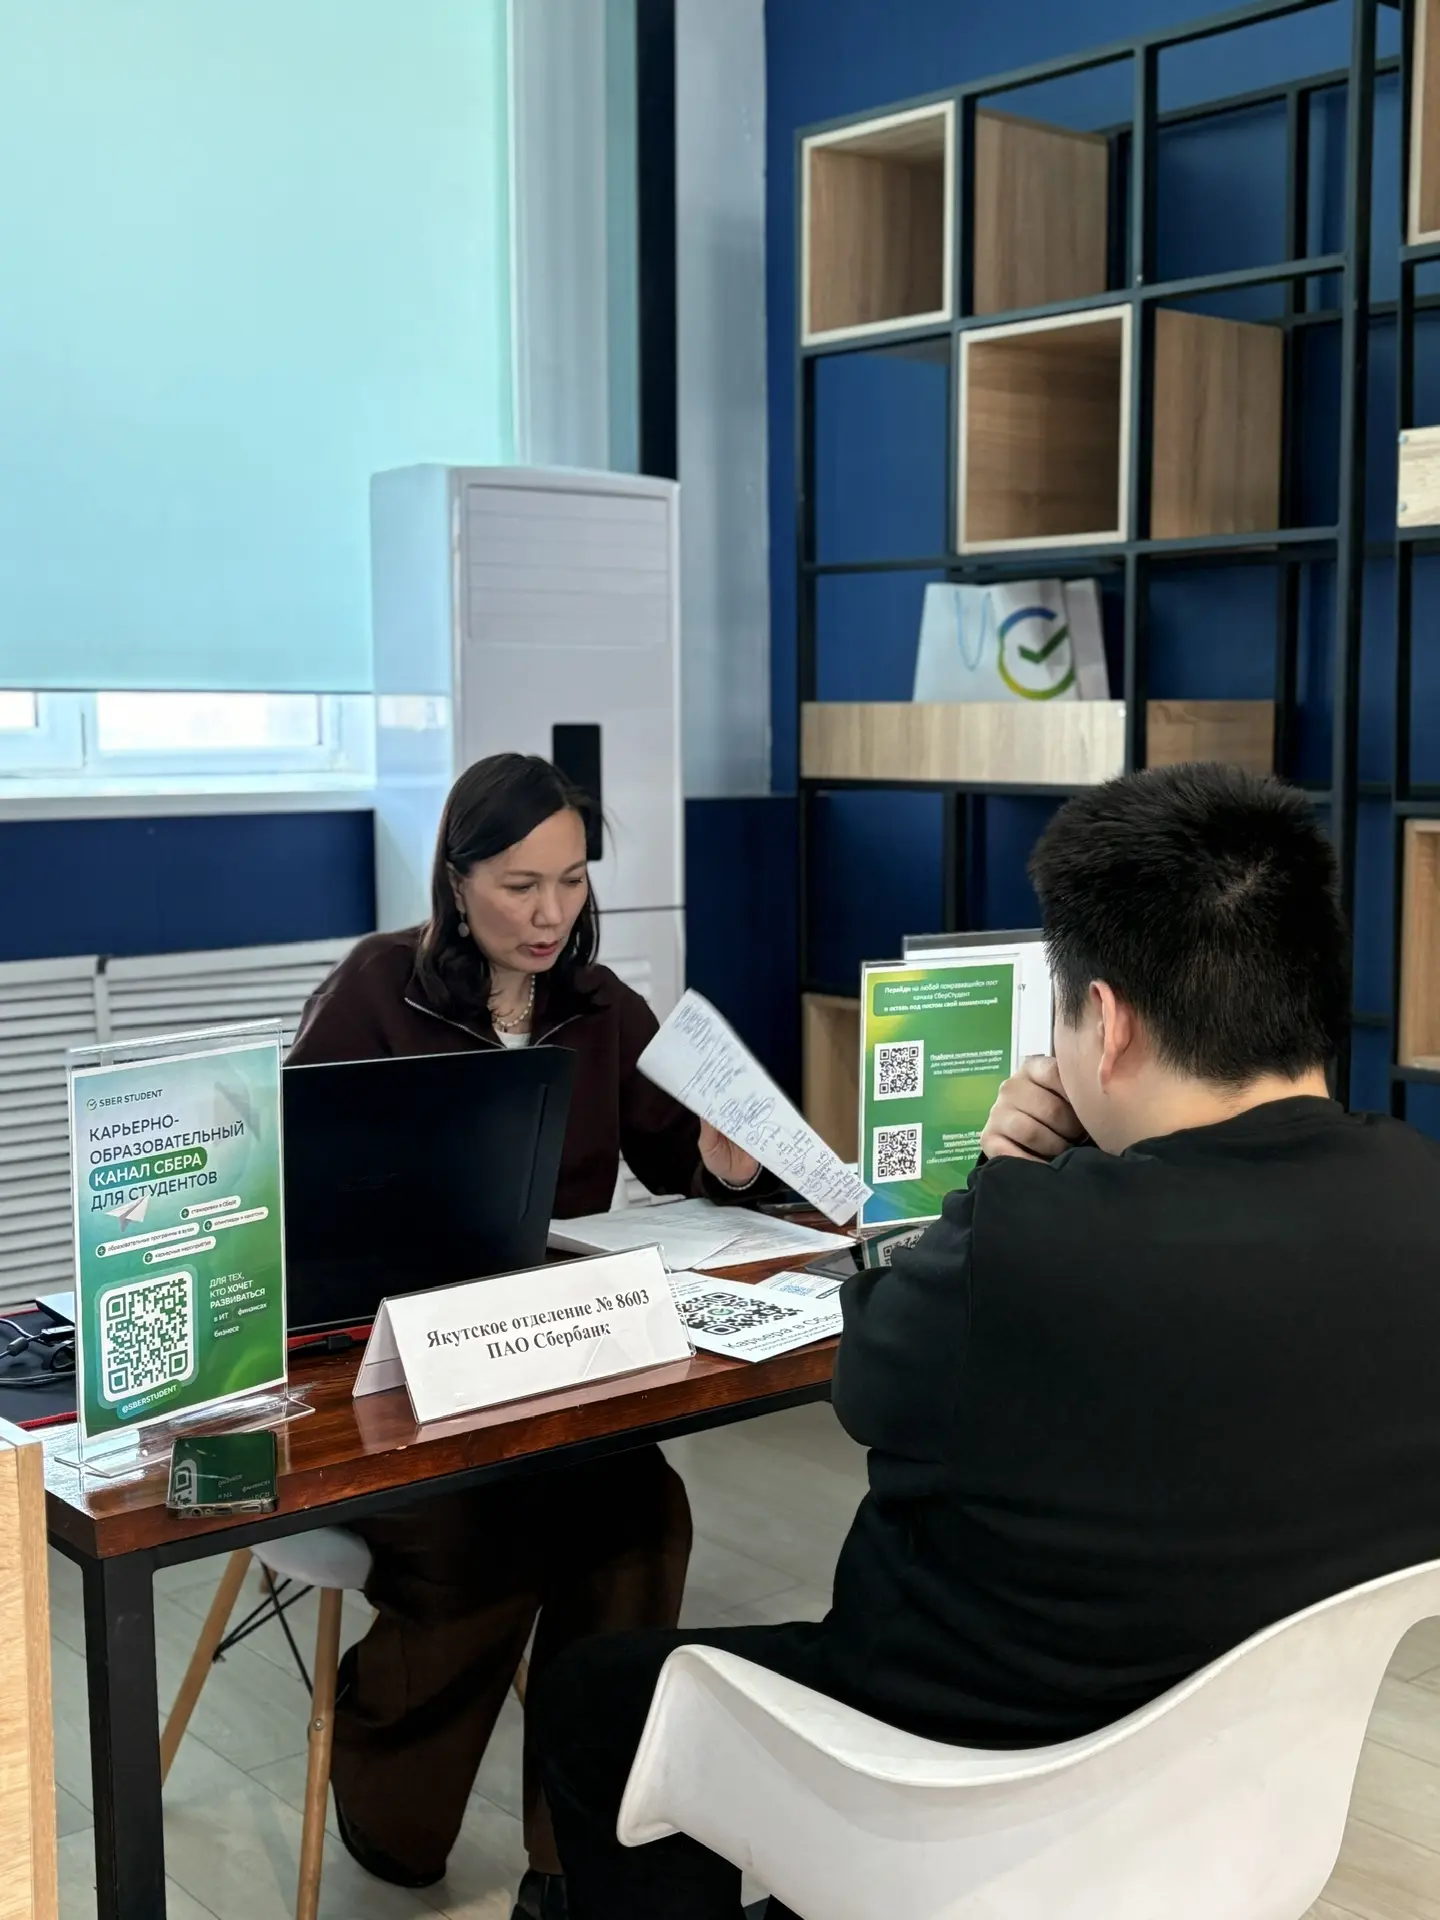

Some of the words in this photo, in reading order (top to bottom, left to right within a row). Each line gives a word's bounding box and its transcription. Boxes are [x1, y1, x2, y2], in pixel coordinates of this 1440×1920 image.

[99, 1096, 123, 1108] SBER
[124, 1089, 163, 1104] STUDENT
[89, 1113, 180, 1142] КАРЬЕРНО-
[89, 1120, 245, 1165] ОБРАЗОВАТЕЛЬНЫЙ
[94, 1163, 150, 1187] КАНАЛ
[153, 1152, 202, 1175] СБЕРА
[91, 1189, 124, 1212] ДЛЯ
[128, 1171, 218, 1200] СТУДЕНТОВ
[209, 1276, 227, 1289] ДЛЯ
[228, 1272, 245, 1282] ТЕХ,
[209, 1287, 226, 1298] КТО
[227, 1280, 253, 1293] ХОЧЕТ
[210, 1288, 266, 1309] РАЗВИВАТЬСЯ
[219, 1312, 229, 1321] ИТ
[237, 1303, 267, 1316] финансах
[213, 1325, 240, 1338] бизнесе
[427, 1320, 509, 1348] Якутское
[511, 1303, 593, 1330] отделение
[595, 1296, 614, 1313] №
[615, 1289, 650, 1309] 8603
[486, 1336, 530, 1359] ПАО
[533, 1323, 611, 1349] Сбербанк
[121, 1384, 177, 1414] @SBERSTUDENT
